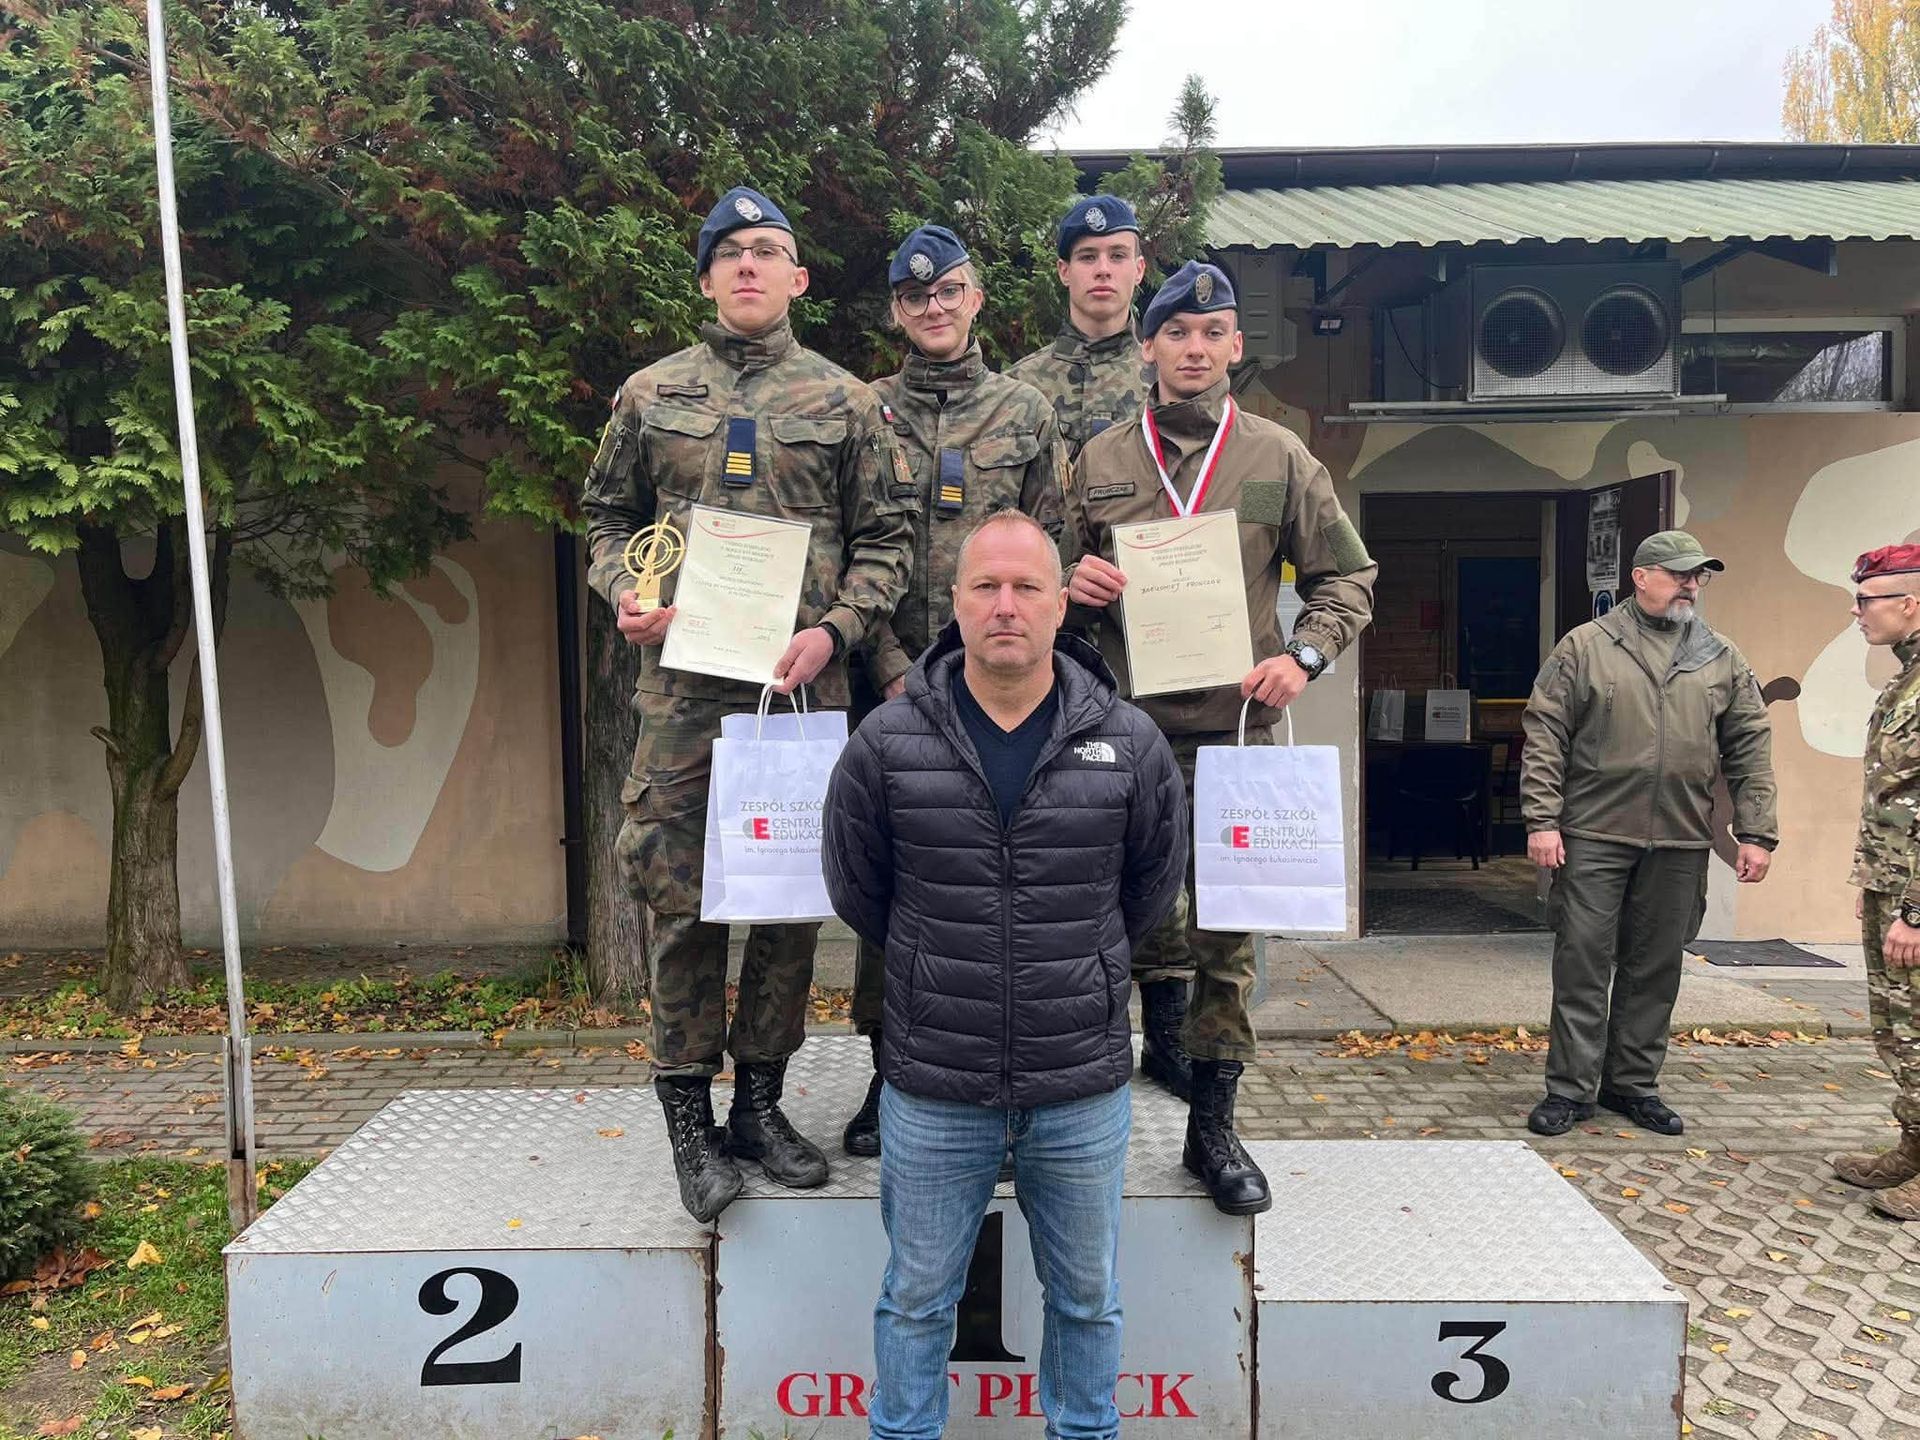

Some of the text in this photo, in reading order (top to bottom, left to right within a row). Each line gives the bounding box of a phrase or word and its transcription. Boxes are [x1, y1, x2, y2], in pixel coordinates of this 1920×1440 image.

[1074, 747, 1100, 755] NORTH
[789, 797, 824, 812] SZKÓ
[1220, 806, 1318, 820] ZESPÓŁ SZKÓŁ
[772, 818, 822, 828] CENTRU
[773, 828, 824, 840] EDUKAC
[1253, 826, 1317, 838] CENTRUM
[1253, 838, 1317, 849] EDUKACJI
[418, 1267, 521, 1386] 2
[1431, 1321, 1510, 1404] 3
[975, 1373, 1199, 1418] PŁCK
